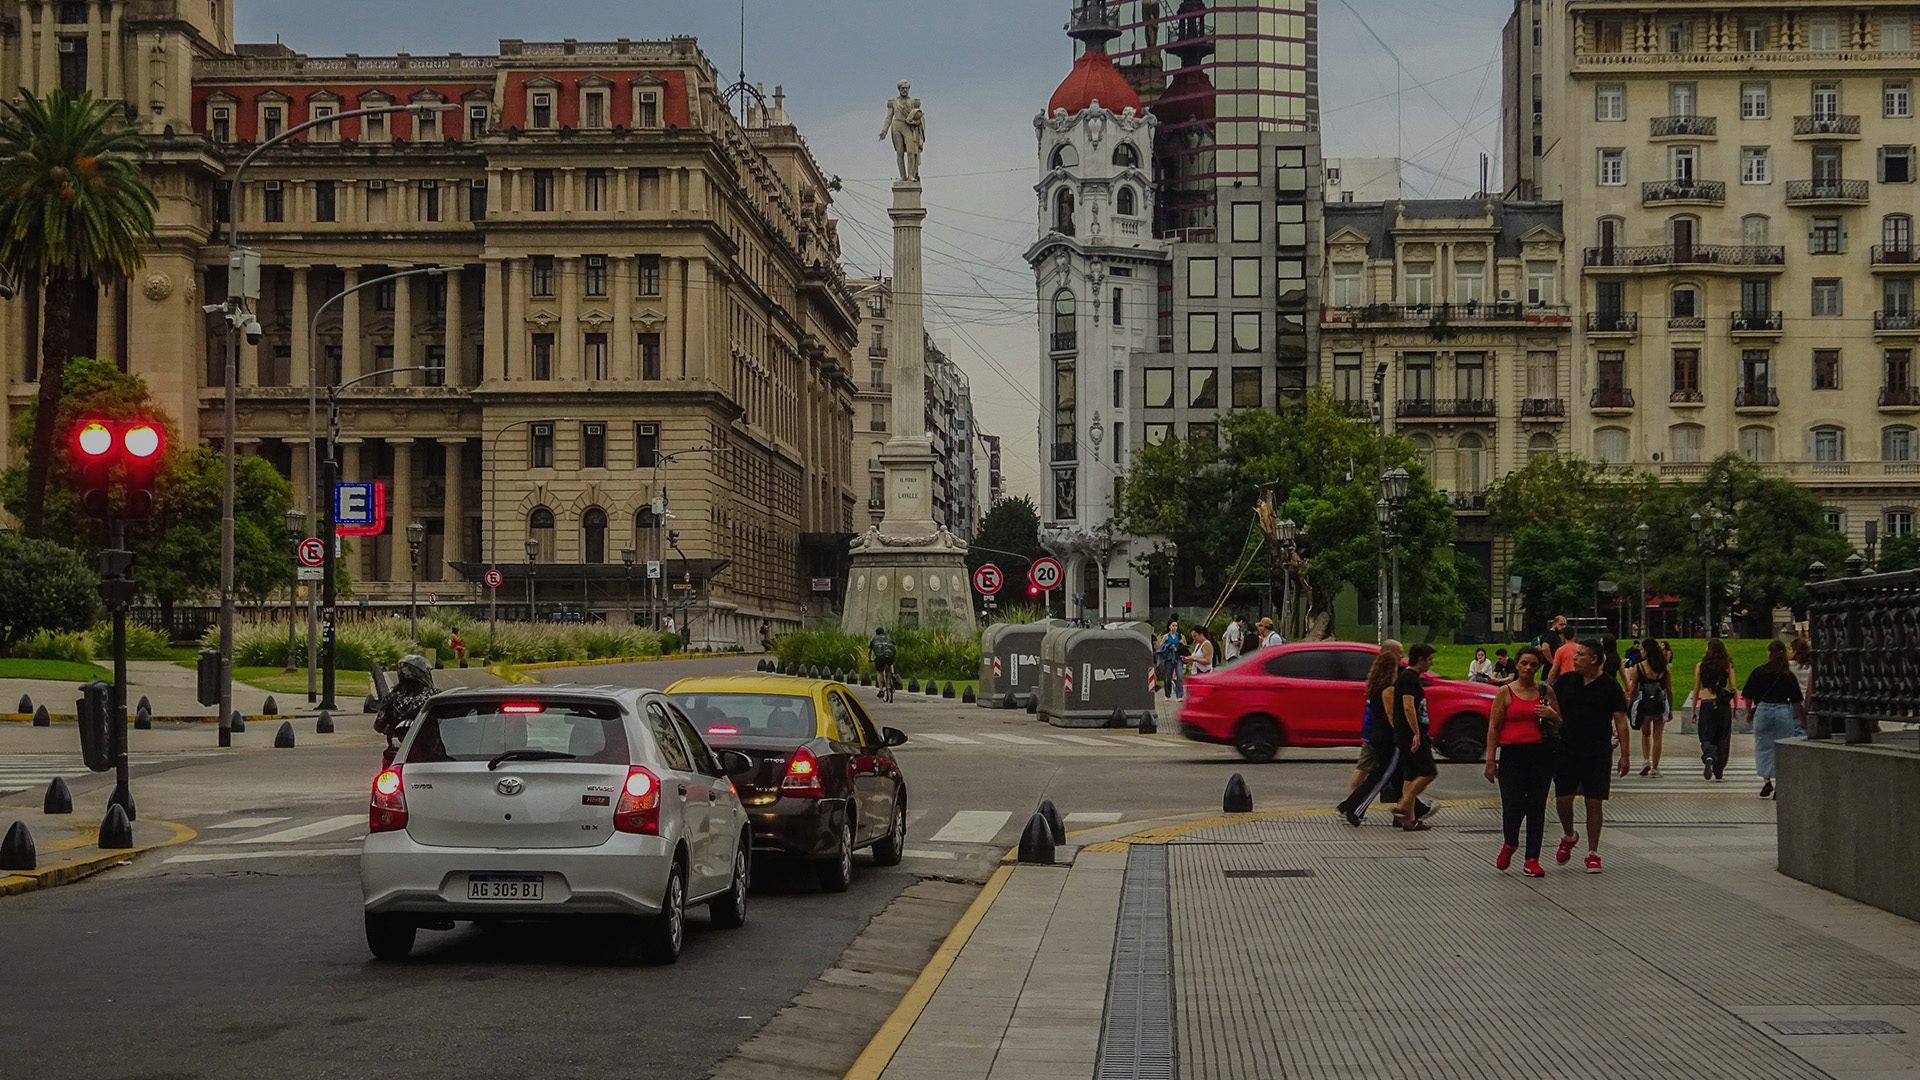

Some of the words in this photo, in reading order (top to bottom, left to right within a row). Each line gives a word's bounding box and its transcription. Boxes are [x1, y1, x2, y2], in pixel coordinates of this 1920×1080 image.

[340, 487, 367, 520] E
[308, 543, 321, 560] E
[982, 571, 995, 588] E
[1037, 568, 1056, 581] 20
[1094, 668, 1116, 681] BA
[471, 883, 489, 897] AG
[493, 883, 518, 897] 305
[522, 883, 538, 898] BI
